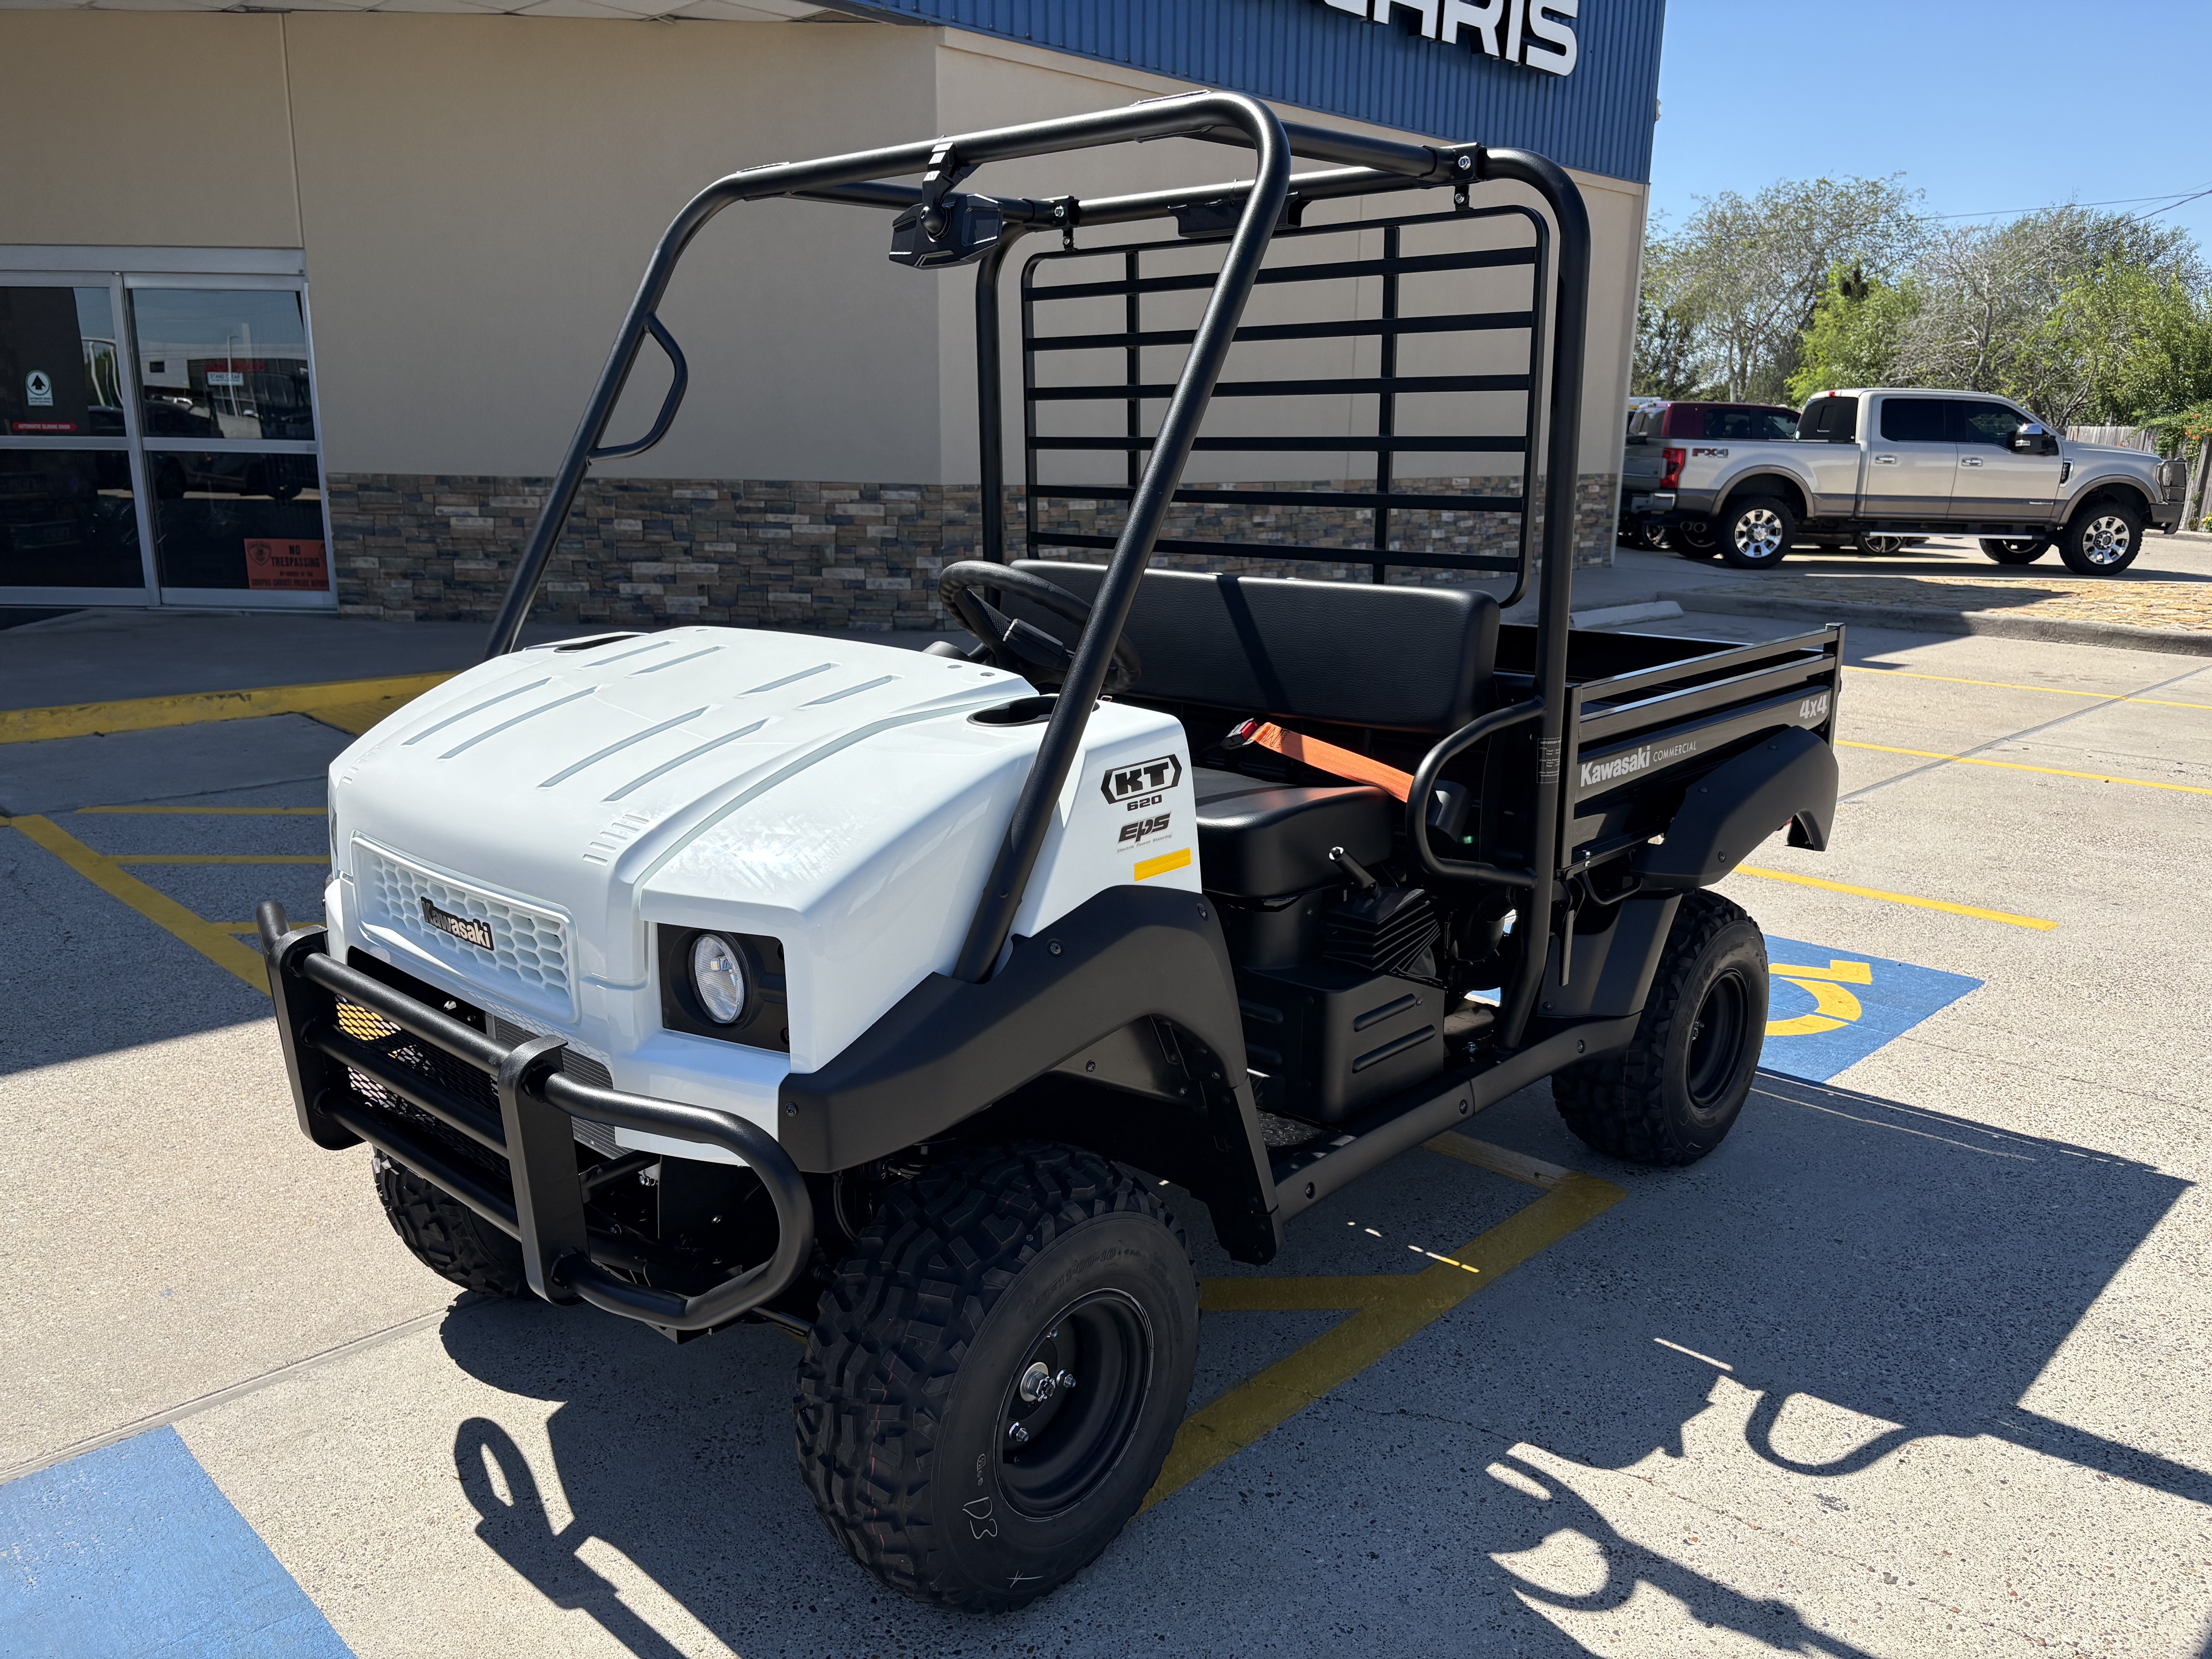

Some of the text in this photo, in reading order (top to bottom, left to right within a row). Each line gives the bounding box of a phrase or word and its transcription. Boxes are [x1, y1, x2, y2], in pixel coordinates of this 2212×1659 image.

[1324, 0, 1578, 76] RIS
[1692, 448, 1728, 457] FX4
[271, 557, 320, 567] TRESPASSING
[289, 545, 301, 555] NO
[1580, 740, 1697, 787] Kawasaki COMMERCIAL
[1115, 761, 1169, 796] KT
[1127, 794, 1162, 811] 620
[1118, 813, 1171, 842] EPS
[1117, 845, 1135, 853] Electric
[1152, 834, 1172, 842] Steering
[421, 900, 491, 948] Kawasaki
